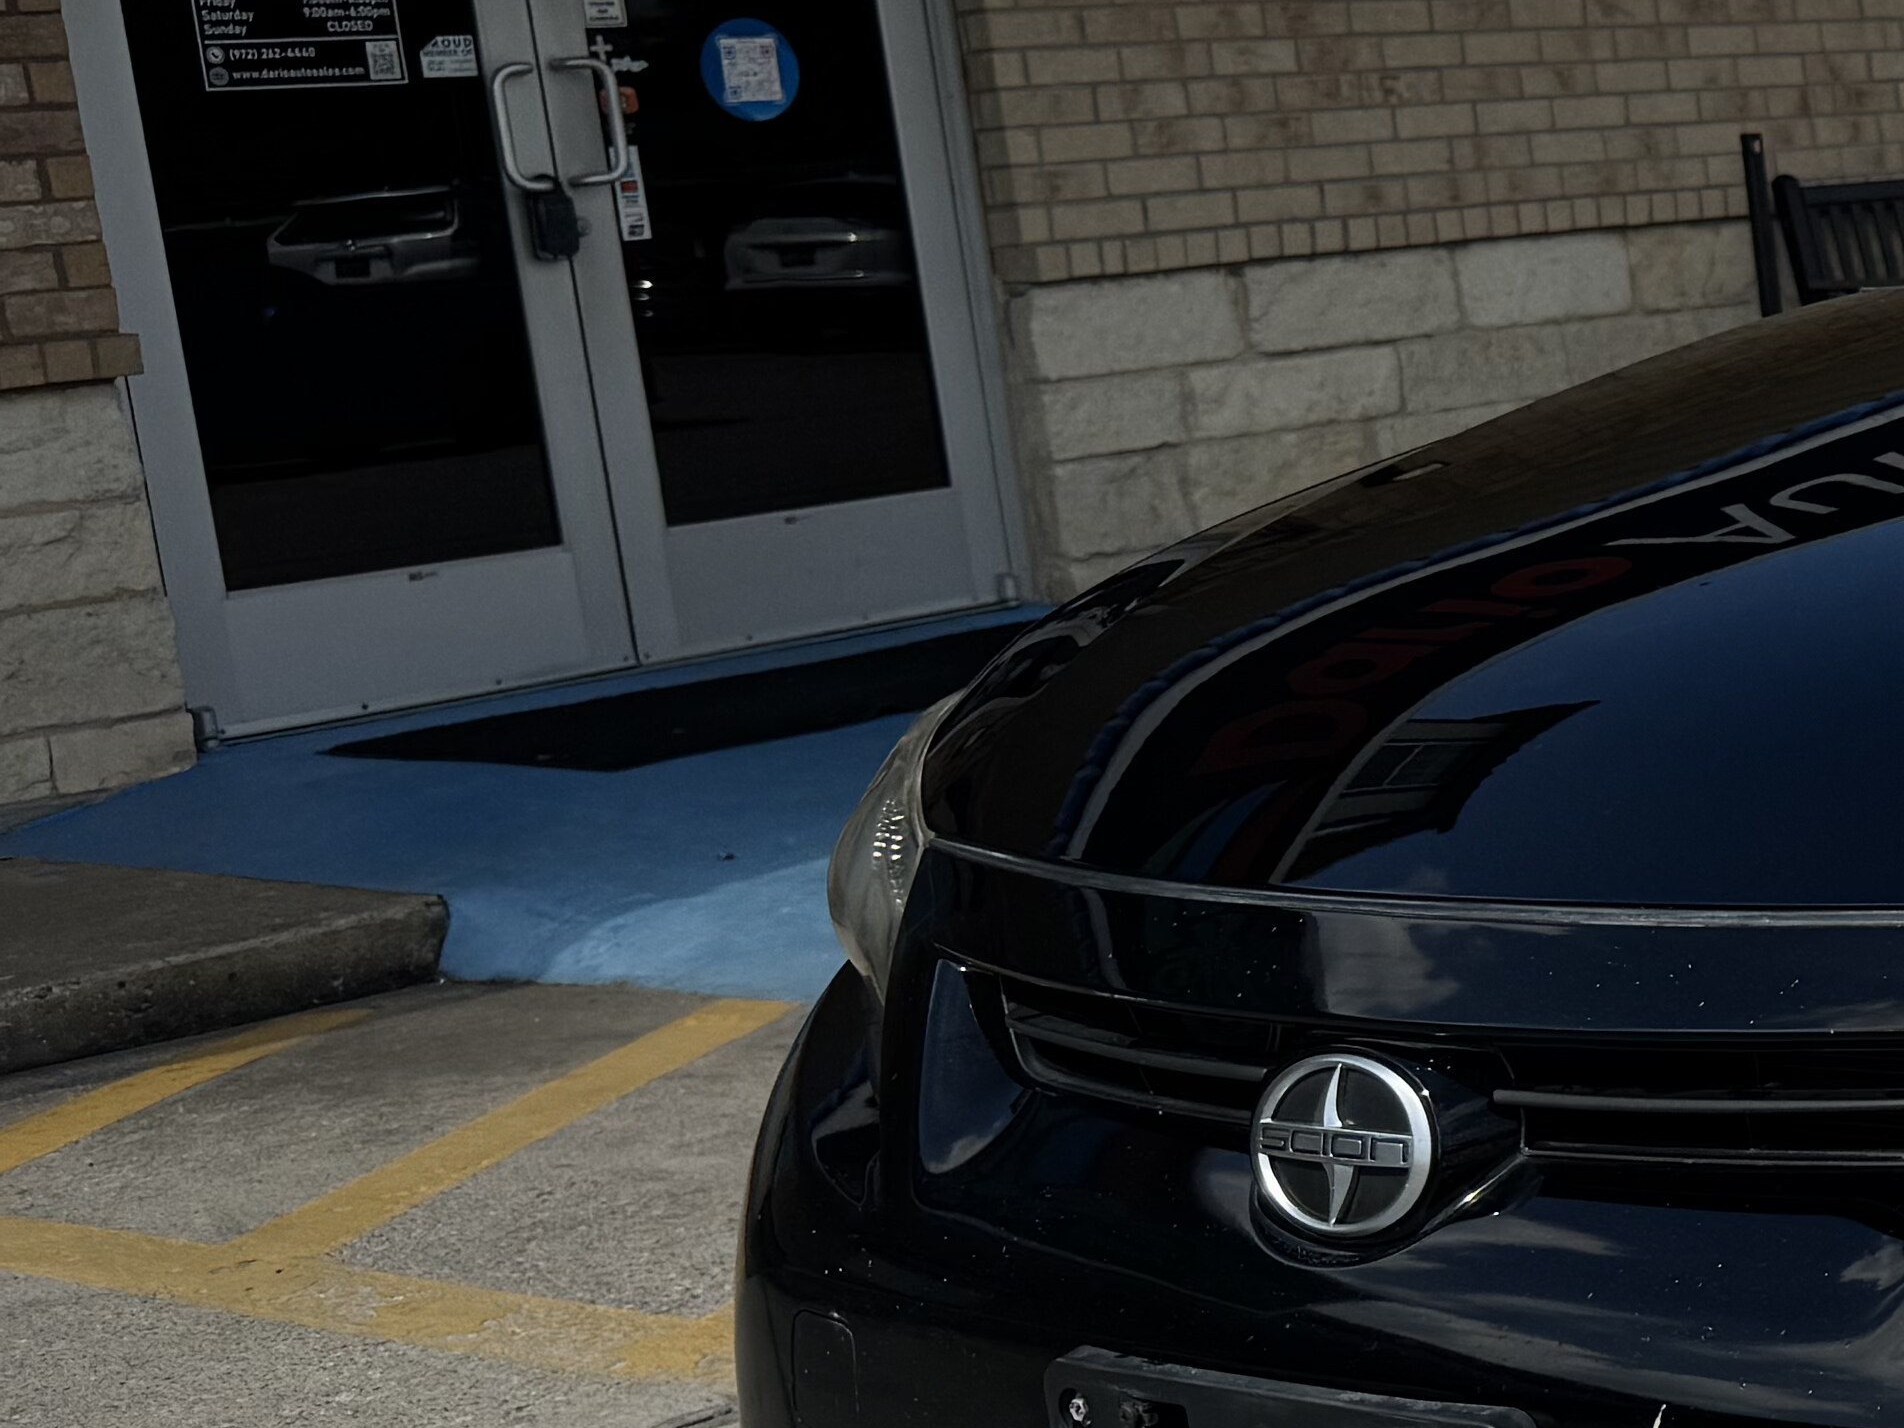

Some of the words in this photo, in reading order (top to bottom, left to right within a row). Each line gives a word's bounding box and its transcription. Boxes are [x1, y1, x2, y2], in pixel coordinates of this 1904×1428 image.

[201, 8, 254, 22] Saturday
[204, 22, 248, 37] Sunday
[327, 19, 374, 32] CLOSED
[229, 47, 258, 62] (972)
